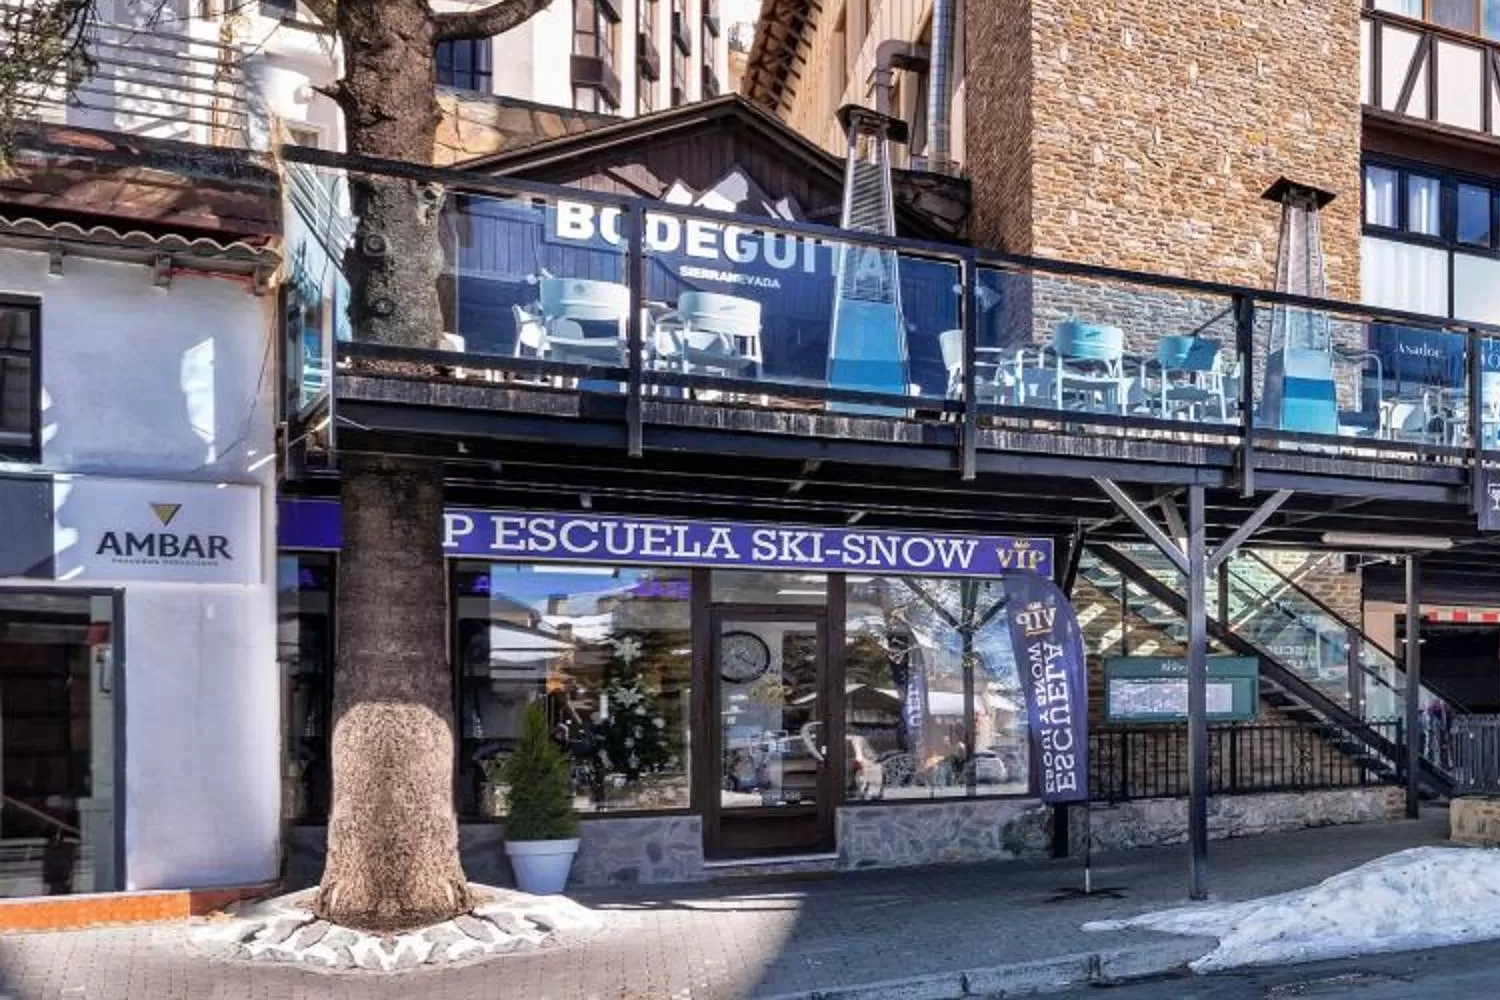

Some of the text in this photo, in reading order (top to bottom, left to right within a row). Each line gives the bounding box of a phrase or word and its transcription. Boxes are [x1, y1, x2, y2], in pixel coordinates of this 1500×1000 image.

[95, 531, 233, 561] AMBAR
[489, 515, 742, 560] ESCUELA
[752, 529, 978, 569] SKI-SNOW
[995, 546, 1047, 569] VIP
